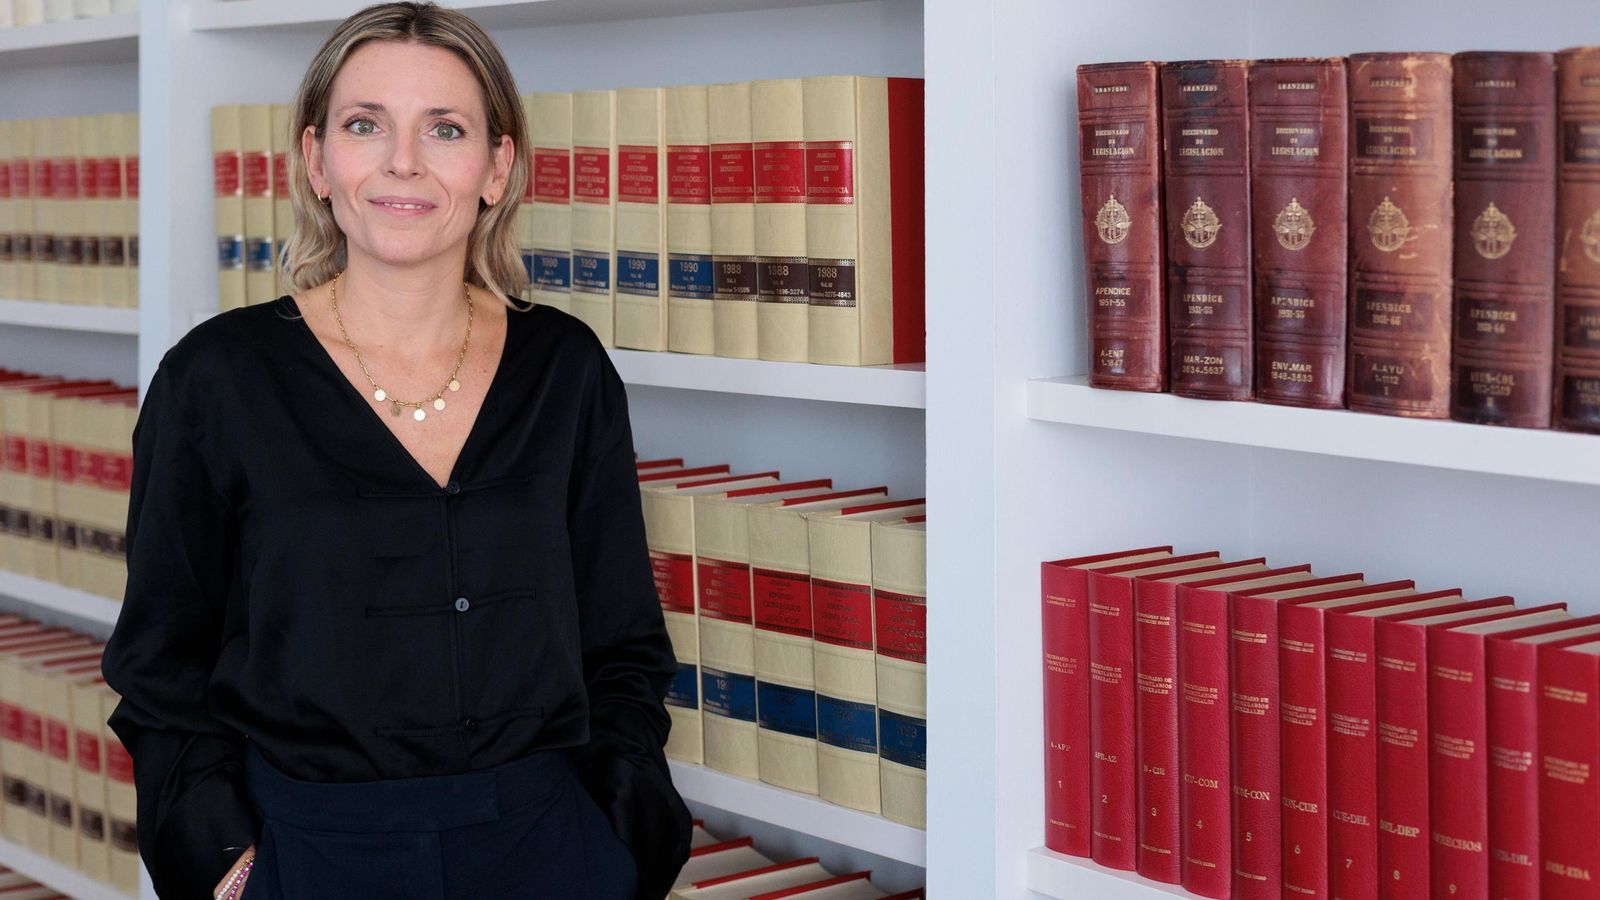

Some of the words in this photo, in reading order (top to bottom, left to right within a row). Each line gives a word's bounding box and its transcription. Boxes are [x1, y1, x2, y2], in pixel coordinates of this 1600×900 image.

[581, 258, 597, 269] 1990
[628, 259, 646, 270] 1990
[680, 262, 698, 272] 1990
[722, 264, 741, 274] 1988
[768, 265, 788, 276] 1988
[817, 267, 837, 278] 1988
[1184, 294, 1223, 303] APENDICE
[1271, 297, 1315, 307] APENDICE
[1366, 301, 1412, 313] APENDICE
[1183, 355, 1223, 365] MAR-ZON
[1272, 361, 1312, 372] ENV-MAR
[1058, 780, 1062, 789] 1
[1102, 794, 1108, 804] 2
[1151, 808, 1157, 816] 3
[1196, 820, 1203, 829] 4
[1246, 832, 1252, 842] 5
[1294, 845, 1301, 854] 6
[1345, 858, 1352, 868] 7
[1394, 869, 1400, 880] 8
[1449, 884, 1456, 894] 9
